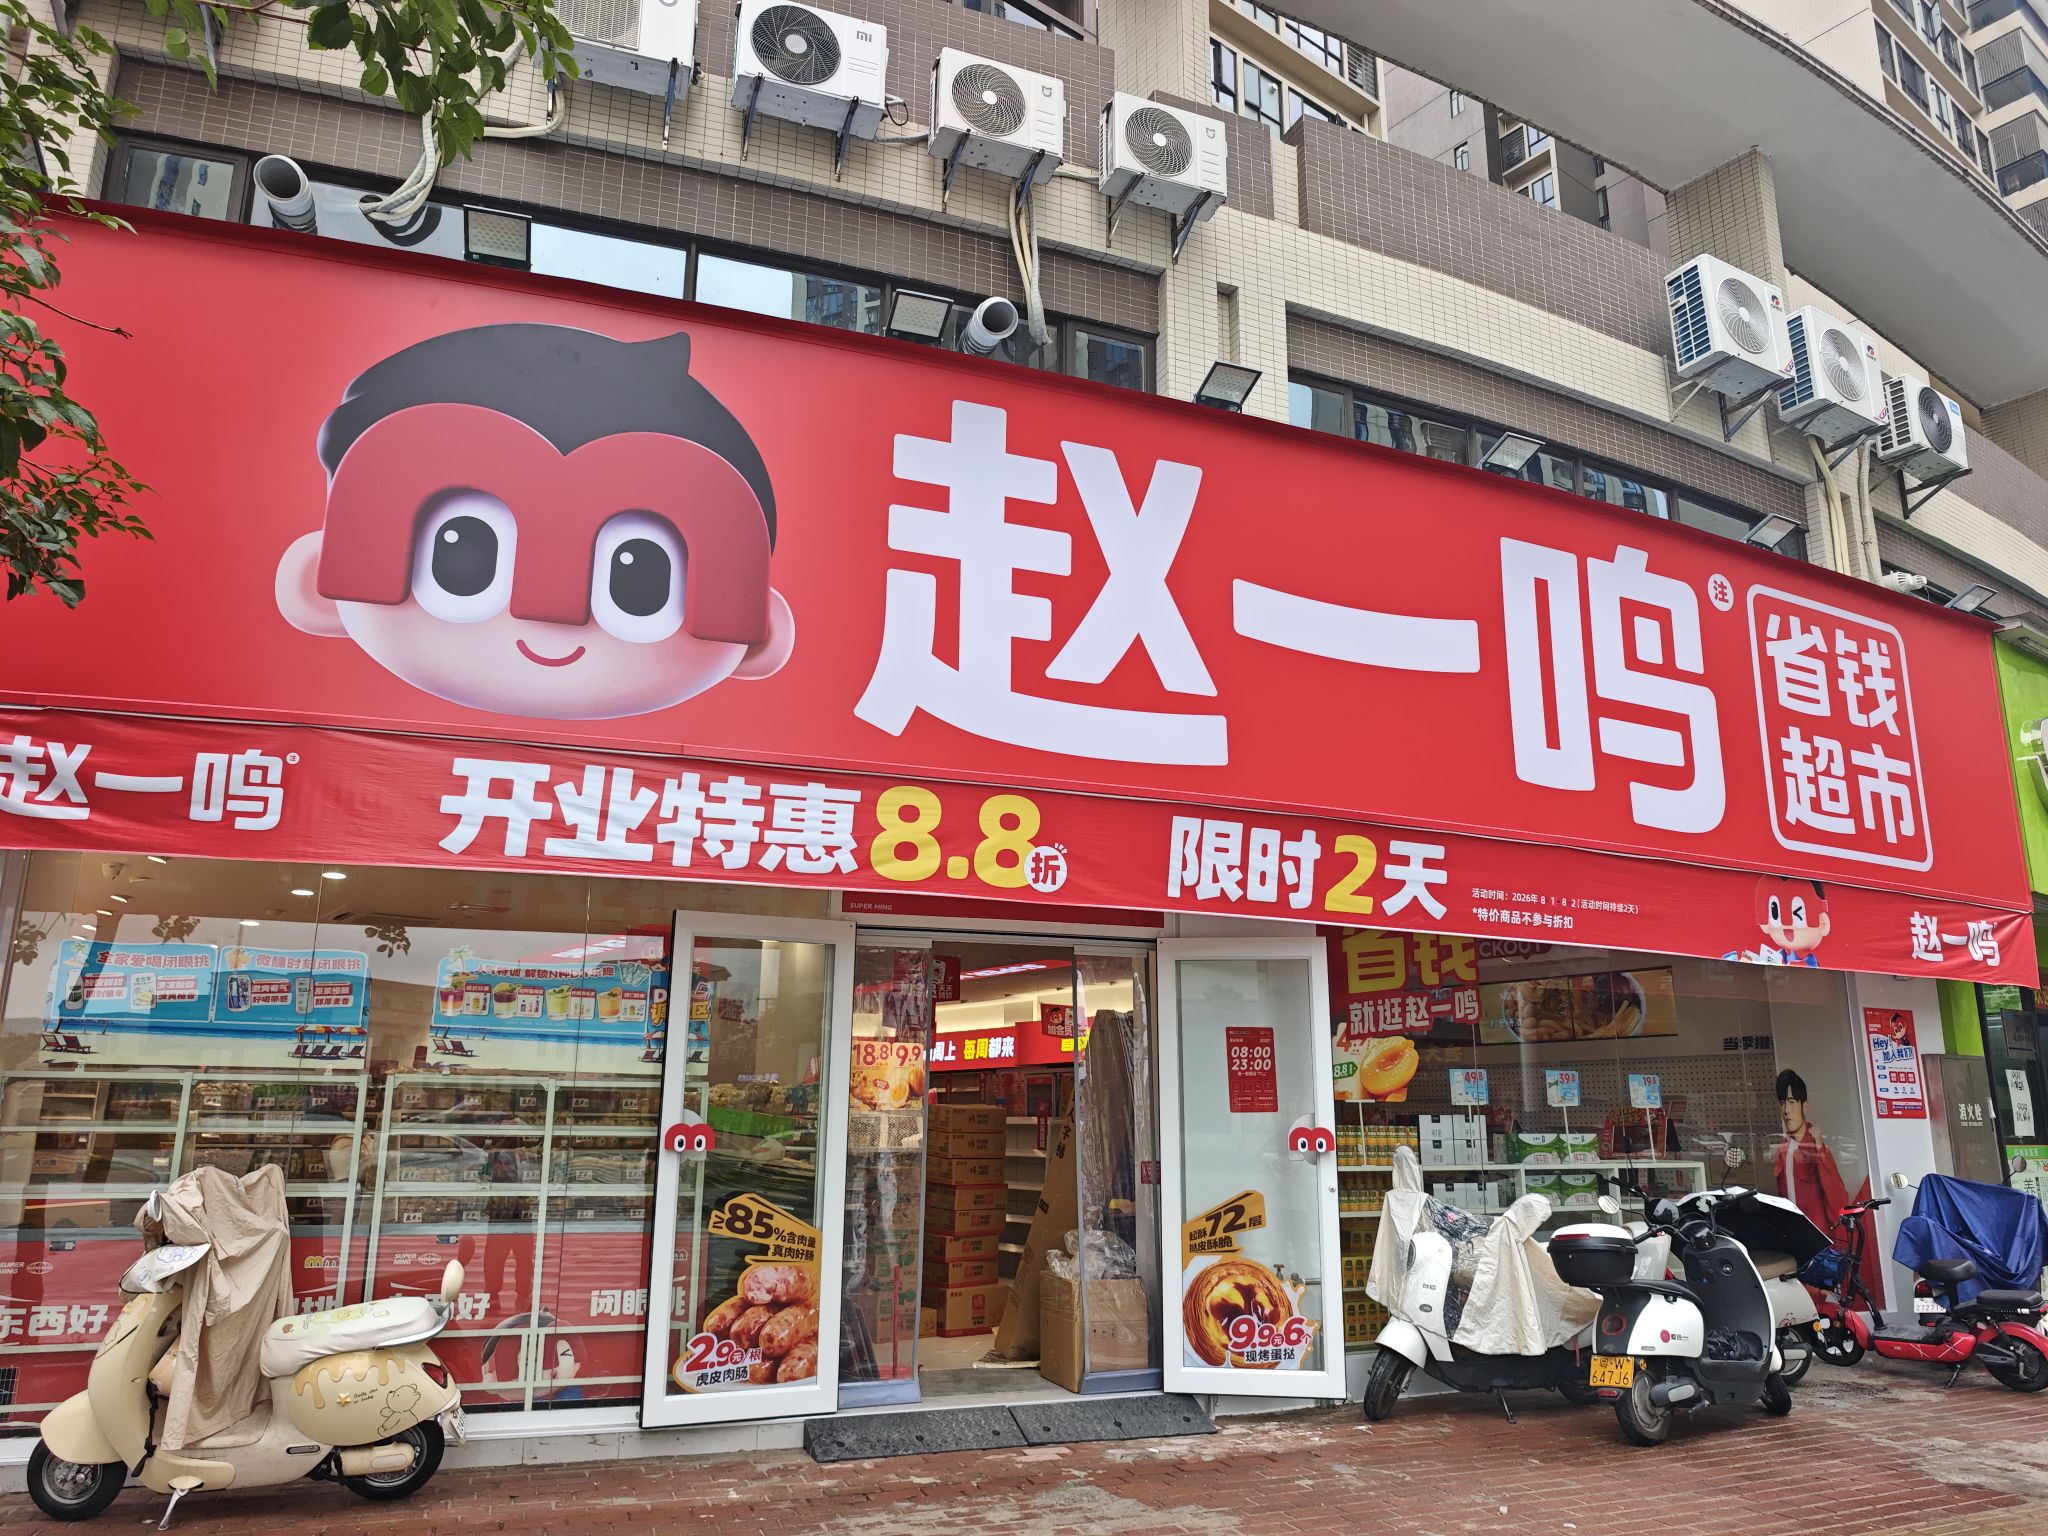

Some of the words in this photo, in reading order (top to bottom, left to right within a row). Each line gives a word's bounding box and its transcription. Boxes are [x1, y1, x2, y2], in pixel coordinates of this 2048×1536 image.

[854, 400, 1726, 834] 赵一鸣
[1766, 613, 1900, 736] 省钱
[0, 735, 285, 831] 赵一鸣
[1780, 726, 1915, 844] 超市
[1167, 816, 1448, 921] 限时2天
[1909, 911, 2000, 967] 赵一鸣
[96, 950, 211, 968] 全家爱喝闭眼挑
[255, 953, 362, 970] 微醺时刻闭眼挑
[1342, 929, 1477, 994] 省钱
[1349, 989, 1479, 1035] 就逛赵一鸣
[963, 1036, 1015, 1060] 每周都来
[1231, 1046, 1271, 1058] 08:00
[1873, 1035, 1893, 1050] Hey!
[853, 1043, 889, 1066] 18.8
[896, 1045, 922, 1067] 9.9
[1231, 1058, 1272, 1071] 23:00
[1959, 1103, 1982, 1120] 消火栓
[1189, 1204, 1263, 1242] 起酥72层
[771, 1243, 815, 1262] 真肉好肠
[1245, 1348, 1296, 1363] 现烤蛋挞
[696, 1366, 749, 1388] 虎皮肉肠
[1592, 1370, 1630, 1386] 647J6
